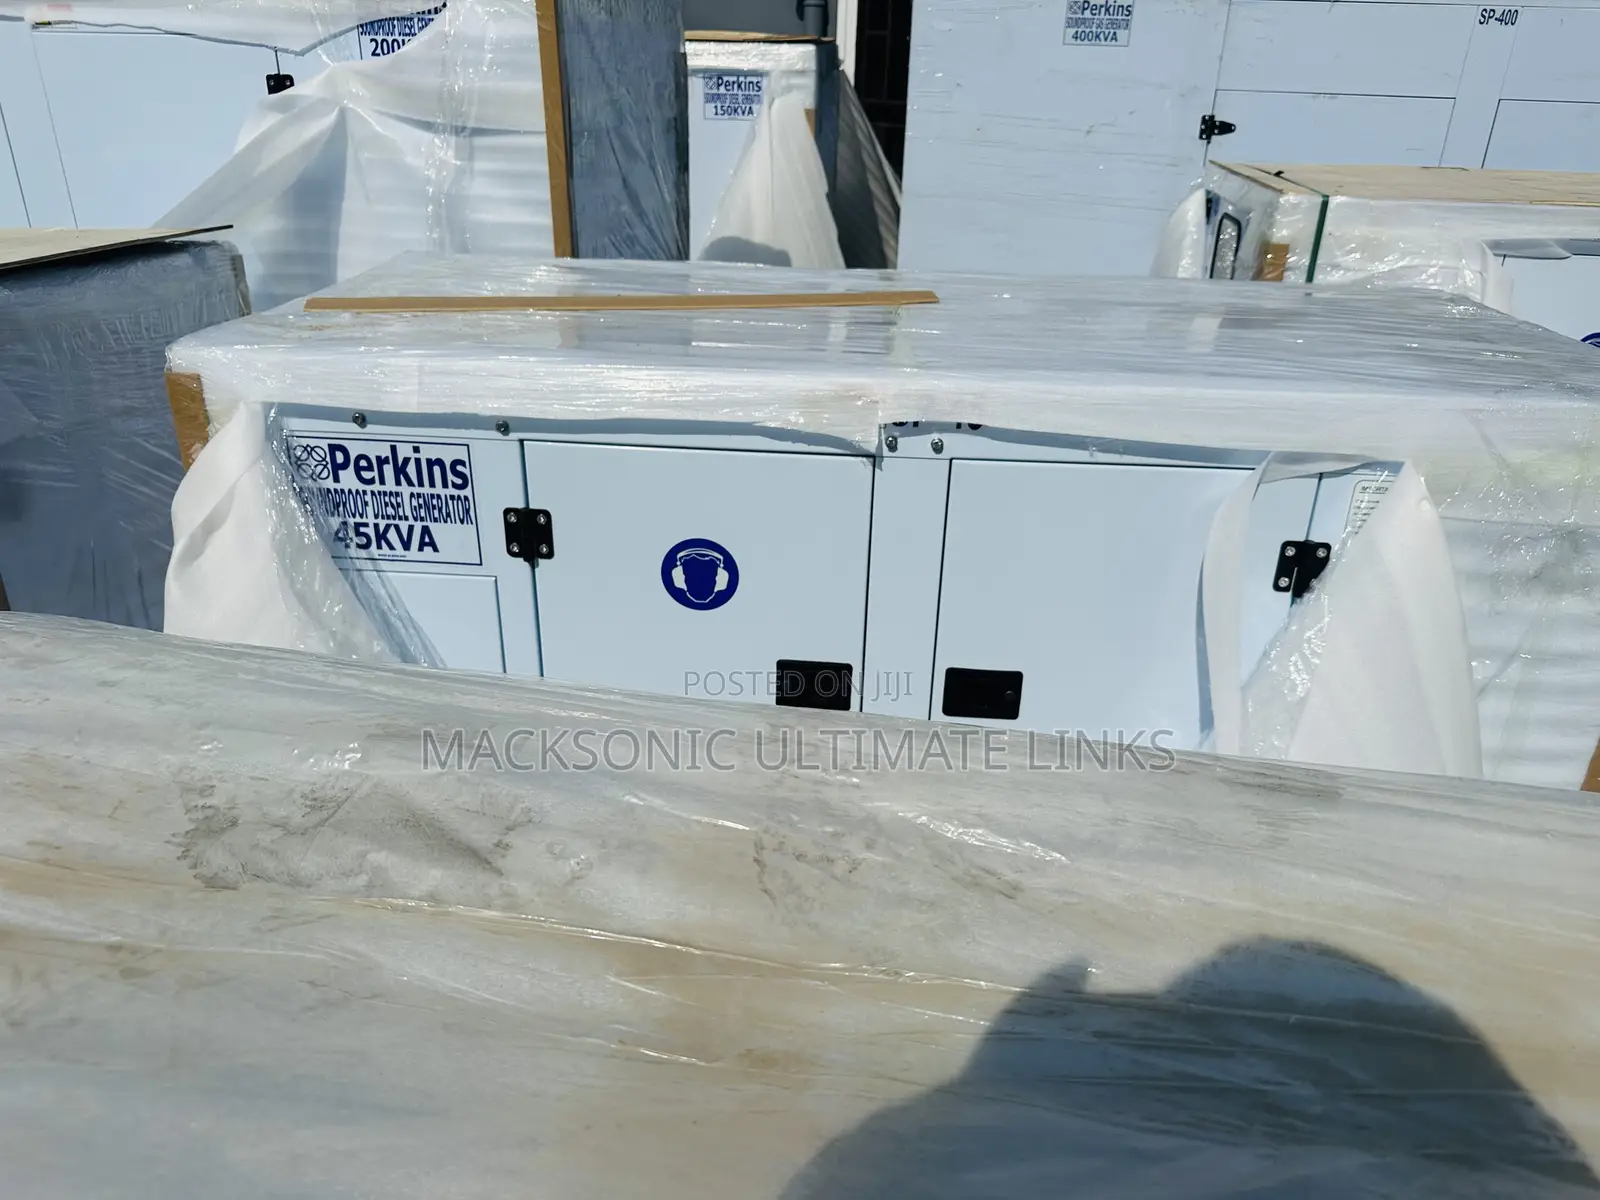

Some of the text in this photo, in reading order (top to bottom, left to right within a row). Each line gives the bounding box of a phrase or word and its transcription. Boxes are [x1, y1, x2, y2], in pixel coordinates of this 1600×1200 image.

[1081, 0, 1132, 17] Perkins
[1479, 8, 1519, 26] SP-400
[1072, 30, 1118, 42] 400KVA
[717, 76, 762, 93] Perkins
[714, 105, 754, 117] 150KVA
[328, 443, 470, 491] Perkins
[370, 489, 410, 521] DIESEL
[410, 491, 474, 525] GENERATOR
[333, 520, 440, 553] 45KVA
